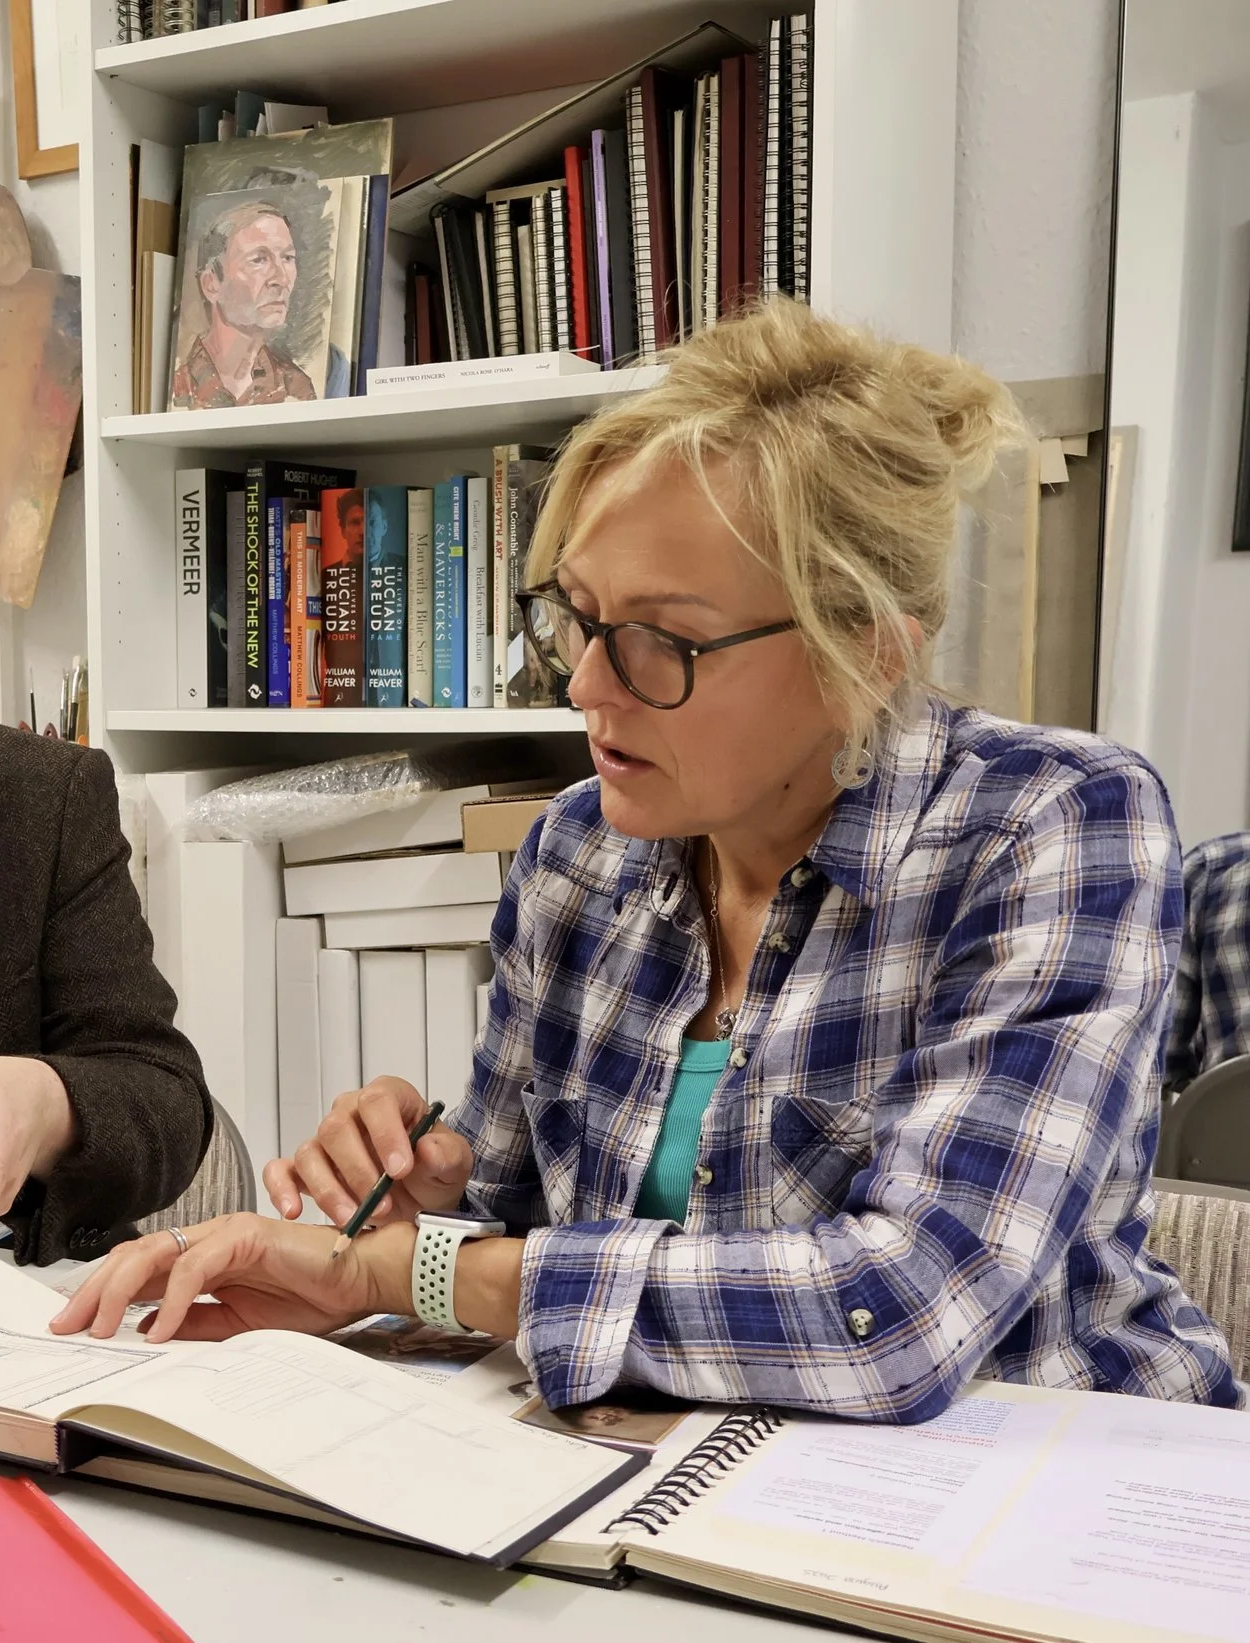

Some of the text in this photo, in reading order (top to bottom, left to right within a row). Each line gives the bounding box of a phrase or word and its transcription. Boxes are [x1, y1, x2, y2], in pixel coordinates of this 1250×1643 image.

[421, 373, 446, 381] FINGERS
[495, 459, 502, 467] A
[284, 470, 337, 487] ROBERT HUGHES
[509, 487, 518, 509] John
[182, 489, 200, 595] VERMEER
[435, 523, 445, 536] &
[510, 511, 519, 557] Constable
[296, 551, 303, 559] IS
[417, 533, 428, 562] Man
[247, 482, 259, 668] THE SHOCK OF THE NEW
[417, 567, 428, 594] with
[325, 569, 337, 631] FREUD
[338, 568, 350, 631] LUCIAN
[370, 567, 382, 631] FREUD
[384, 566, 395, 631] LUCIAN
[435, 542, 445, 640] MAVERICKS
[351, 620, 356, 631] OF
[397, 619, 402, 630] OF
[416, 610, 428, 636] Blue
[476, 567, 485, 661] Breakfast with Lucian
[416, 640, 428, 675] Scarf
[324, 678, 355, 687] FEAVER
[325, 668, 355, 676] WILLIAM
[369, 679, 402, 688] FEAVER
[370, 668, 402, 676] WILLIAM
